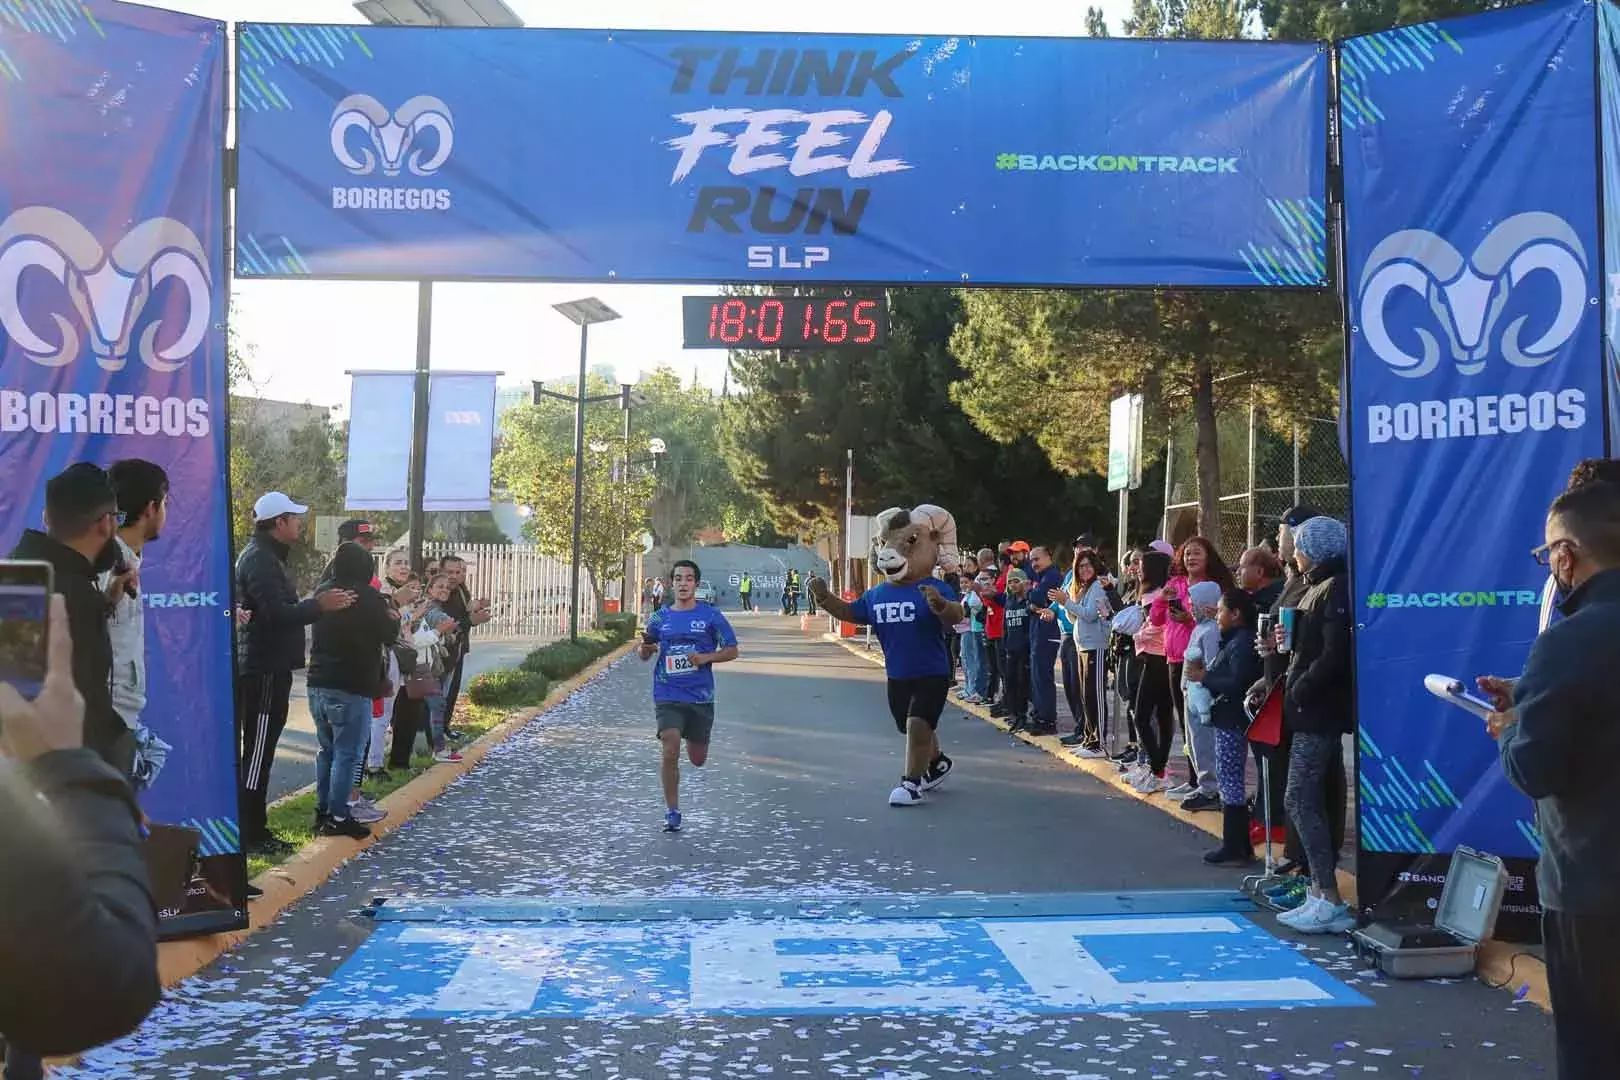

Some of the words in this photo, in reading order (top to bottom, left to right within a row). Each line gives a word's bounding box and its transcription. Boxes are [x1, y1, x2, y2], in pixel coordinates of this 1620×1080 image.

[668, 45, 921, 98] THINK
[660, 106, 914, 186] FEEL
[995, 153, 1238, 173] #BACKONTRACK
[332, 187, 451, 210] BORREGOS
[686, 186, 871, 236] RUN
[747, 246, 830, 269] SLP
[0, 390, 210, 438] BORREGOS
[1367, 388, 1586, 443] BORREGOS
[873, 601, 916, 624] TEC
[398, 917, 1334, 1013] TEC
